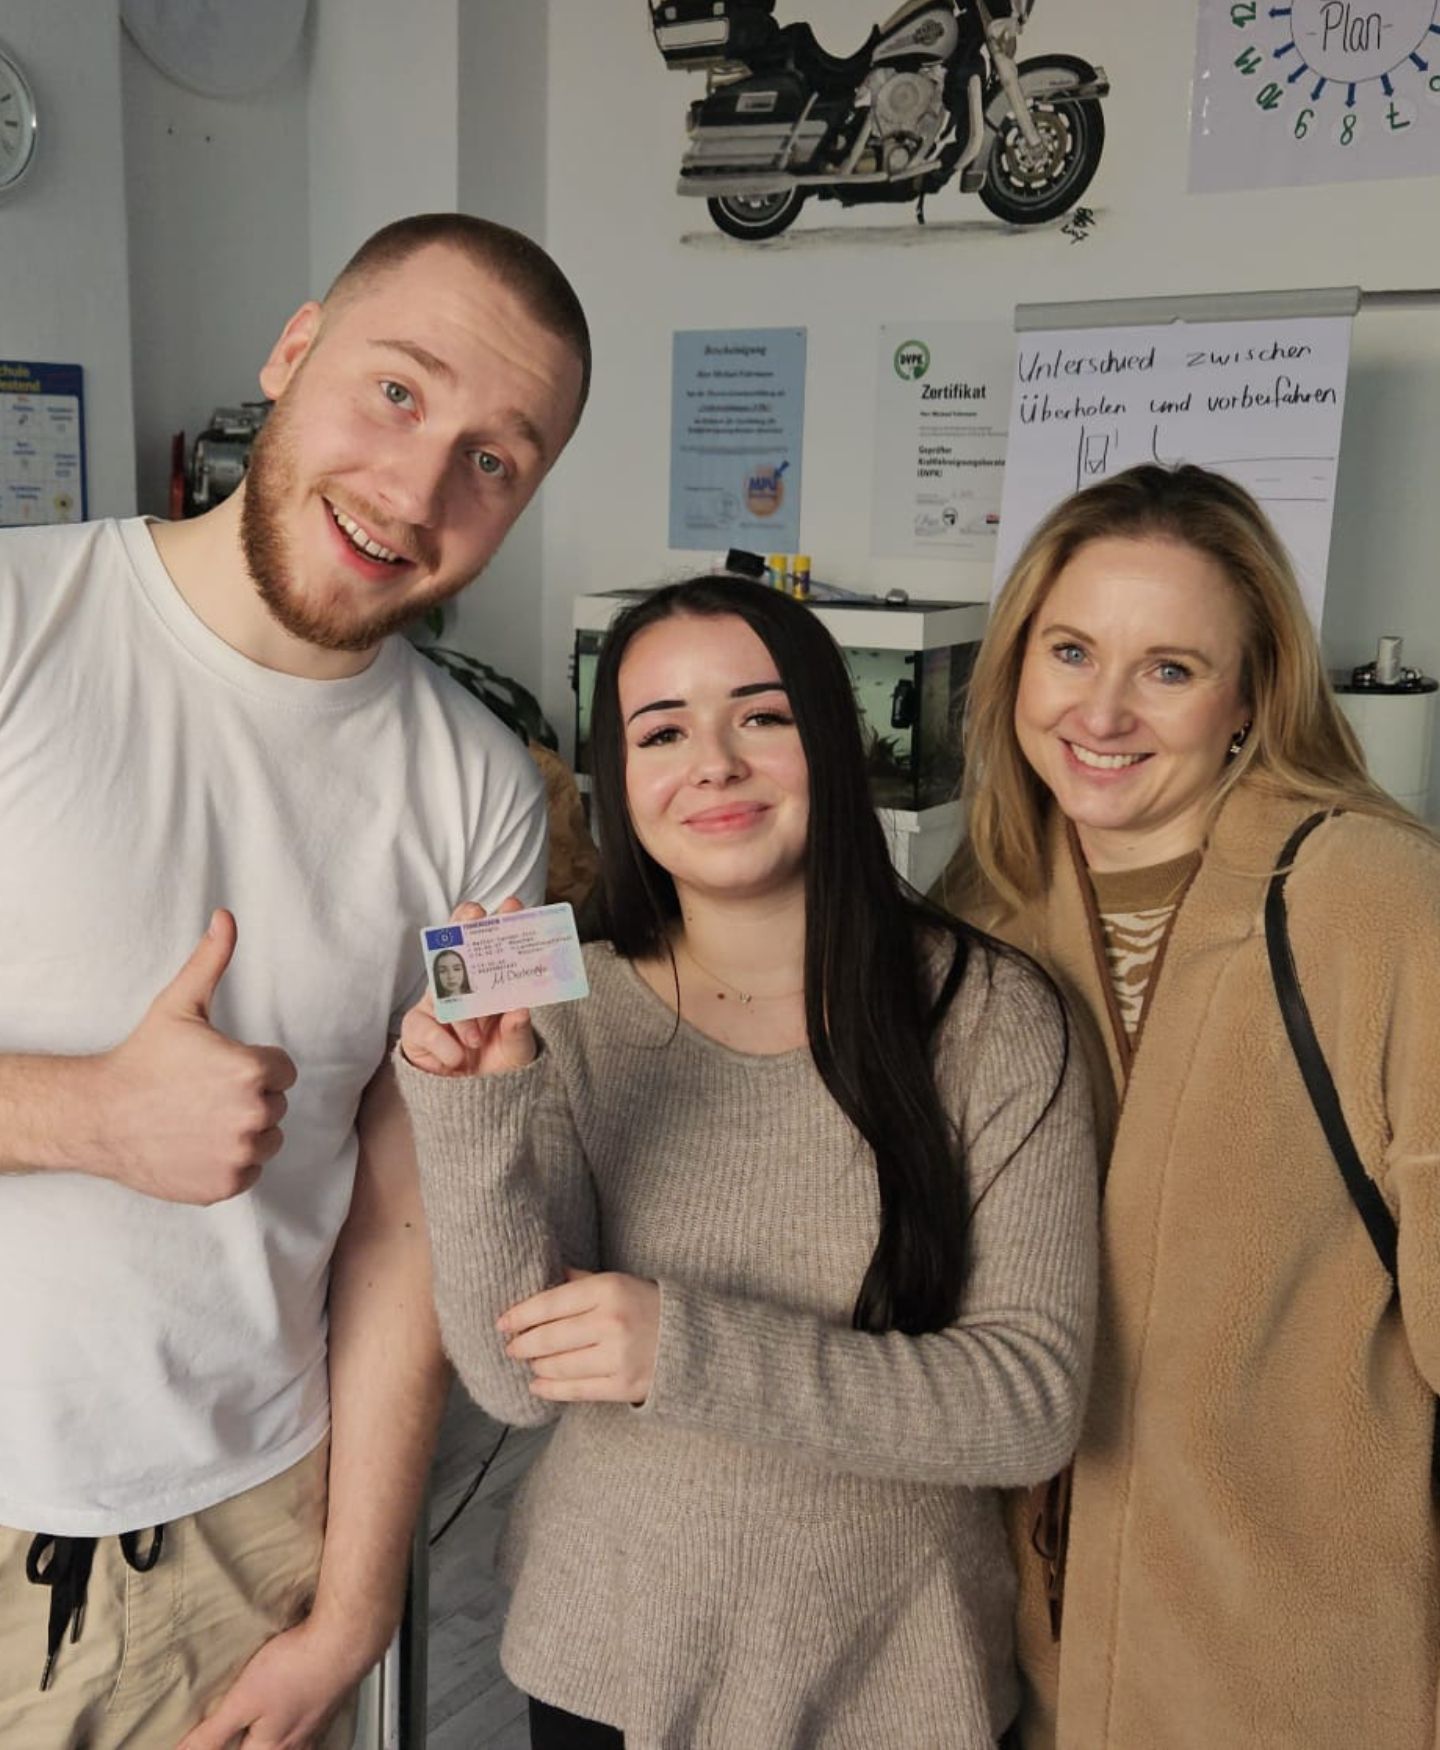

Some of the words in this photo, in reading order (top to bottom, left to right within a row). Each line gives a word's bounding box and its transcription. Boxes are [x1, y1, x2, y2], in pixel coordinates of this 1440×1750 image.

[1340, 114, 1357, 146] 8
[1018, 347, 1155, 382] Unterschied
[1187, 342, 1311, 367] zwischen
[921, 384, 986, 400] Zertifikat
[1020, 394, 1126, 424] Überholen
[1150, 393, 1192, 413] und
[1208, 375, 1337, 412] vorbeifahren
